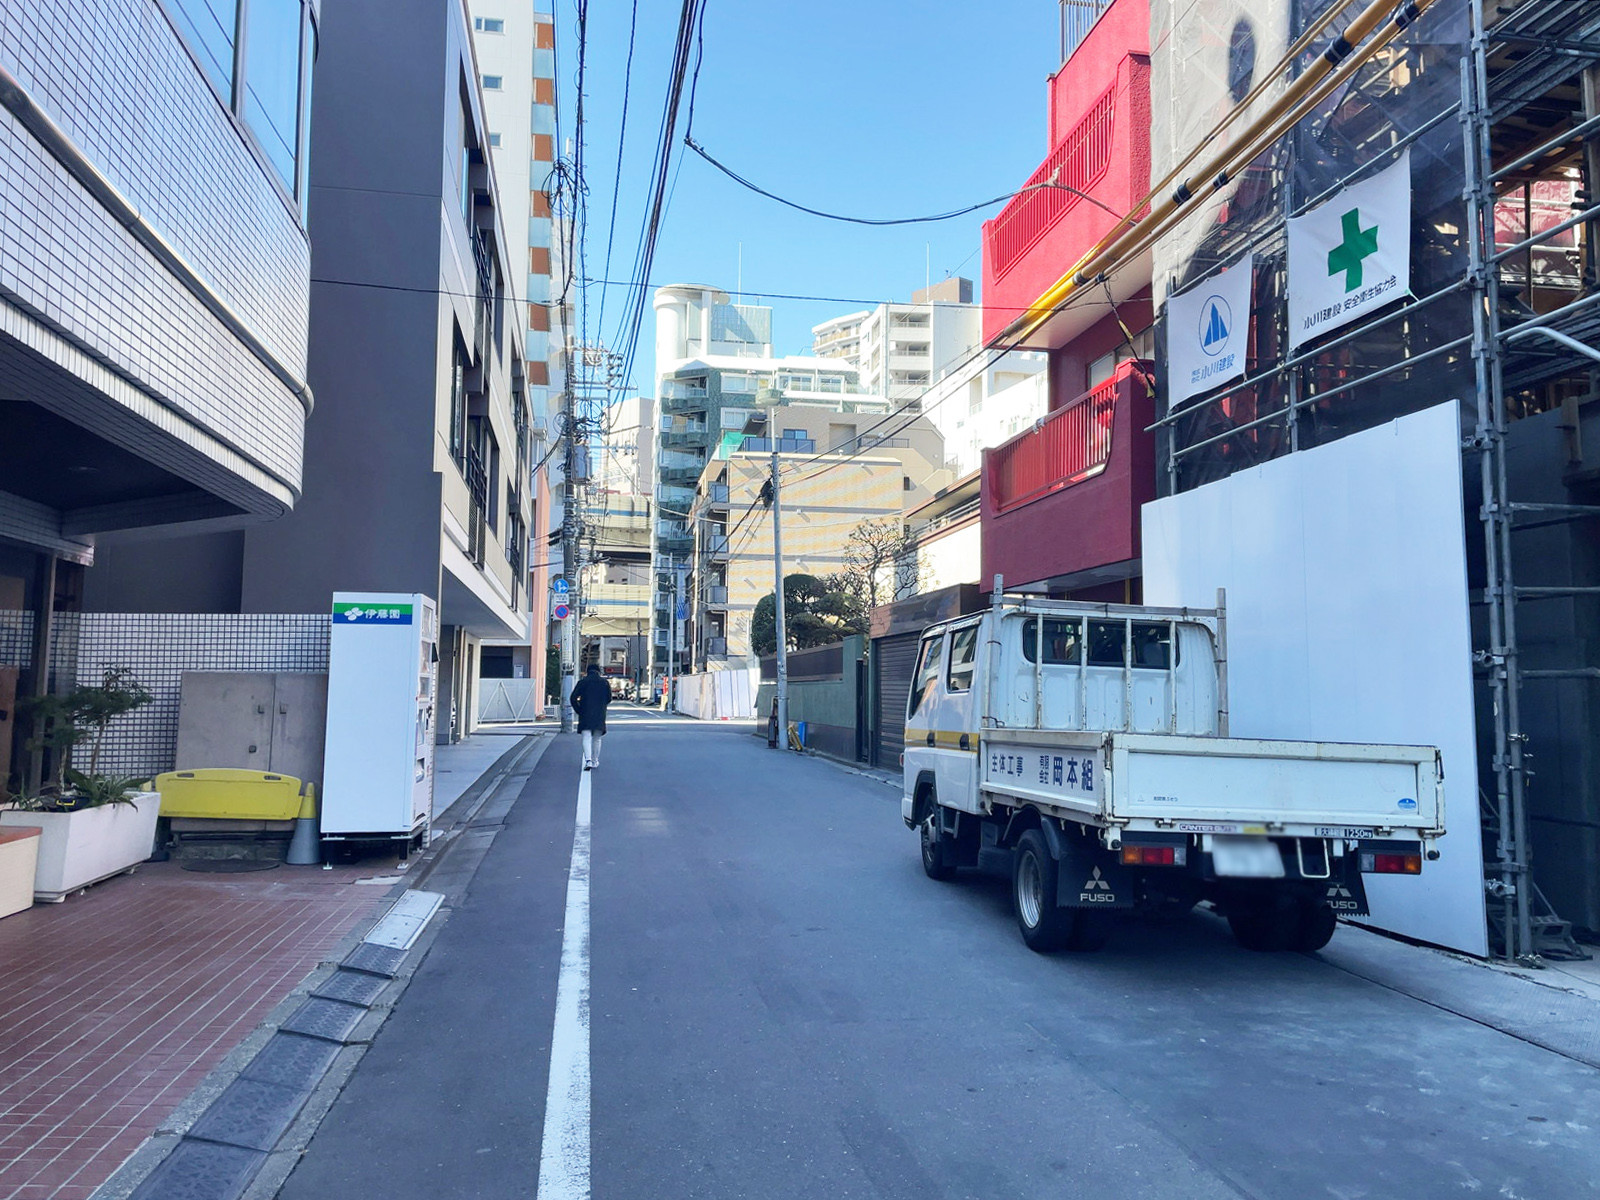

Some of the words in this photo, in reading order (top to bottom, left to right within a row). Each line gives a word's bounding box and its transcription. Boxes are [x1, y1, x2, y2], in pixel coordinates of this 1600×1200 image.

[1303, 303, 1342, 329] 小川建設
[1343, 275, 1397, 312] 安全衛生協力会
[1200, 353, 1234, 380] 小川建設
[365, 608, 401, 619] 伊藤園
[1053, 756, 1094, 792] 岡本組
[1080, 893, 1115, 902] FUSO
[1327, 900, 1358, 910] USO
